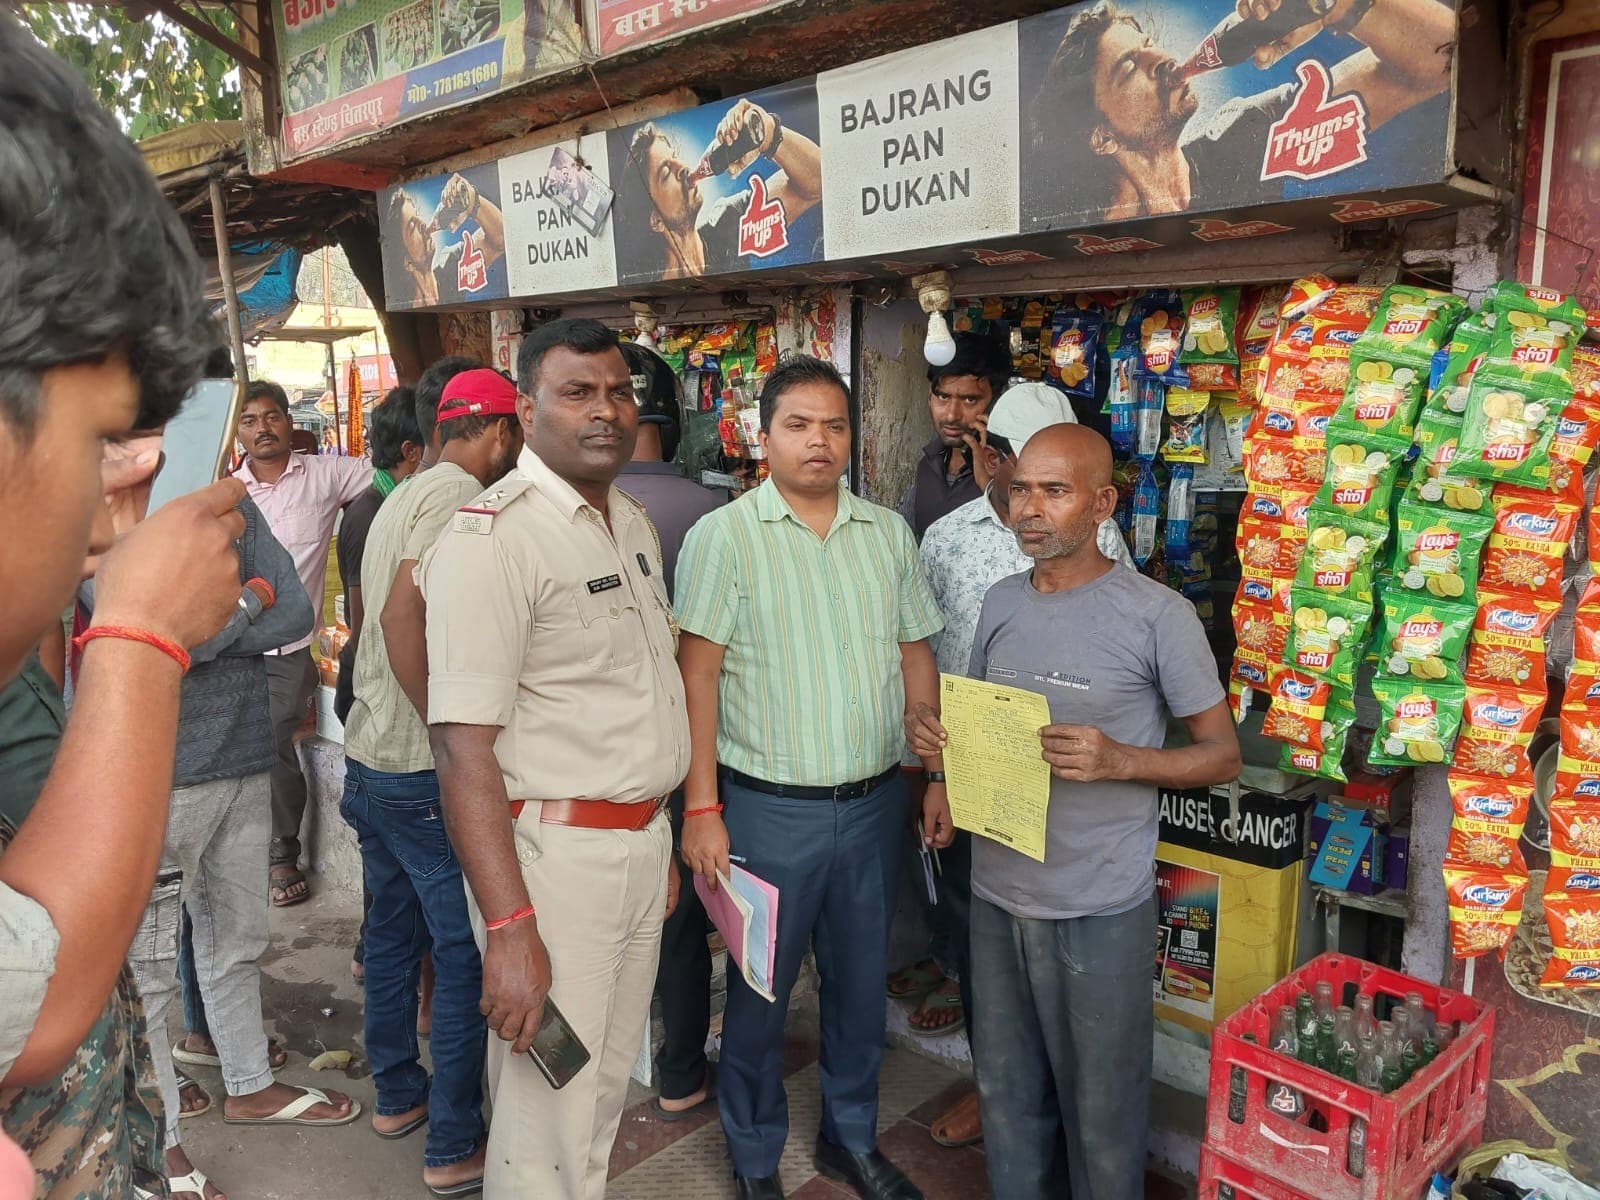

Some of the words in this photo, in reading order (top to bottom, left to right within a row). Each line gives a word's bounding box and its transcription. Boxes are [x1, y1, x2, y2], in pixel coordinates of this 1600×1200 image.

[613, 2, 664, 37] बस
[841, 69, 991, 133] BAJRANG
[1274, 111, 1357, 161] Thums
[883, 126, 944, 168] PAN
[862, 167, 970, 216] DUKAN
[537, 206, 571, 231] PAN
[743, 212, 781, 241] Thums
[527, 236, 589, 265] DUKAN
[1326, 330, 1364, 343] Kurku
[1559, 420, 1586, 433] kure
[1552, 443, 1576, 457] EXTRA
[1421, 533, 1455, 550] Lay's
[1526, 541, 1551, 553] EXTRA
[1404, 621, 1438, 640] Lay's
[1485, 634, 1503, 643] 50%
[1508, 637, 1532, 649] EXTRA
[1060, 673, 1091, 684] EDITION
[1401, 701, 1432, 719] Lay's
[1472, 728, 1488, 738] 50%
[1493, 731, 1517, 743] EXTRA
[1158, 793, 1217, 839] AUSES
[1220, 812, 1297, 850] CANCER
[1464, 821, 1482, 830] 50%
[1486, 825, 1511, 835] EXTRA
[1328, 844, 1352, 856] PERK
[1571, 857, 1595, 867] EXTRA
[1463, 912, 1480, 920] 50%
